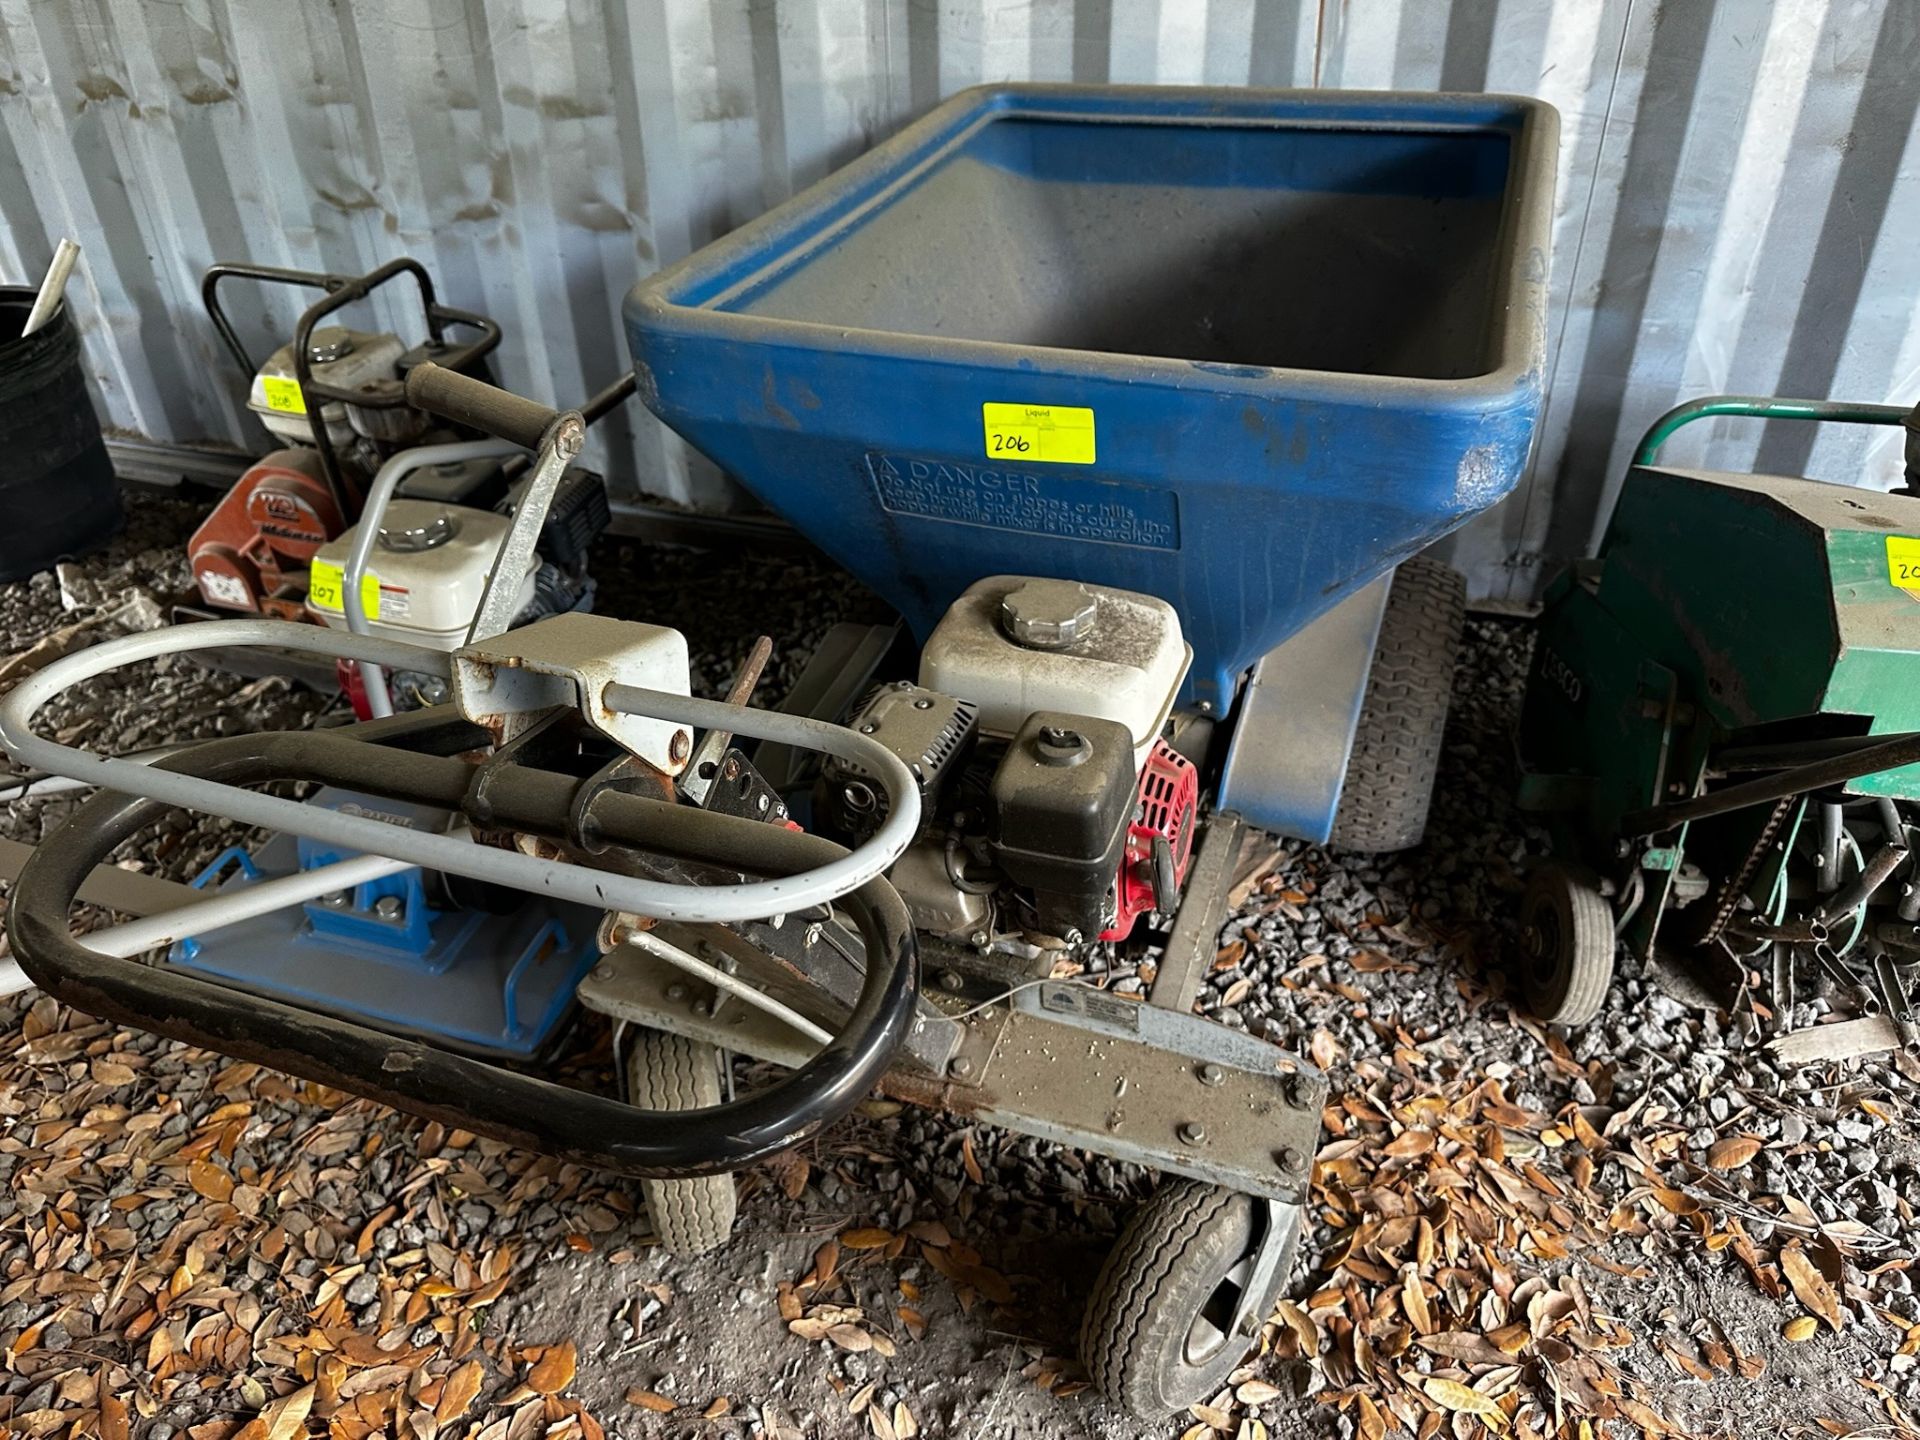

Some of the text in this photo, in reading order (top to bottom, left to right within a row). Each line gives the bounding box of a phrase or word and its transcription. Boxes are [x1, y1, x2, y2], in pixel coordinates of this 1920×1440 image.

[1025, 408, 1050, 417] Liquid
[992, 434, 1030, 452] 206
[909, 461, 1040, 494] DANGER
[910, 478, 941, 494] Not
[946, 484, 977, 498] use
[983, 491, 1005, 503] on
[1012, 493, 1069, 514] slopes
[1075, 503, 1094, 514] or
[929, 490, 979, 510] hands
[984, 501, 1016, 516] and
[1021, 506, 1082, 524] objects
[1087, 515, 1115, 528] out
[1120, 519, 1137, 530] of
[1143, 519, 1171, 533] the
[948, 507, 991, 522] while
[996, 516, 1039, 529] mixer
[1044, 520, 1055, 530] is
[1060, 521, 1074, 533] in
[1079, 526, 1169, 545] operation.
